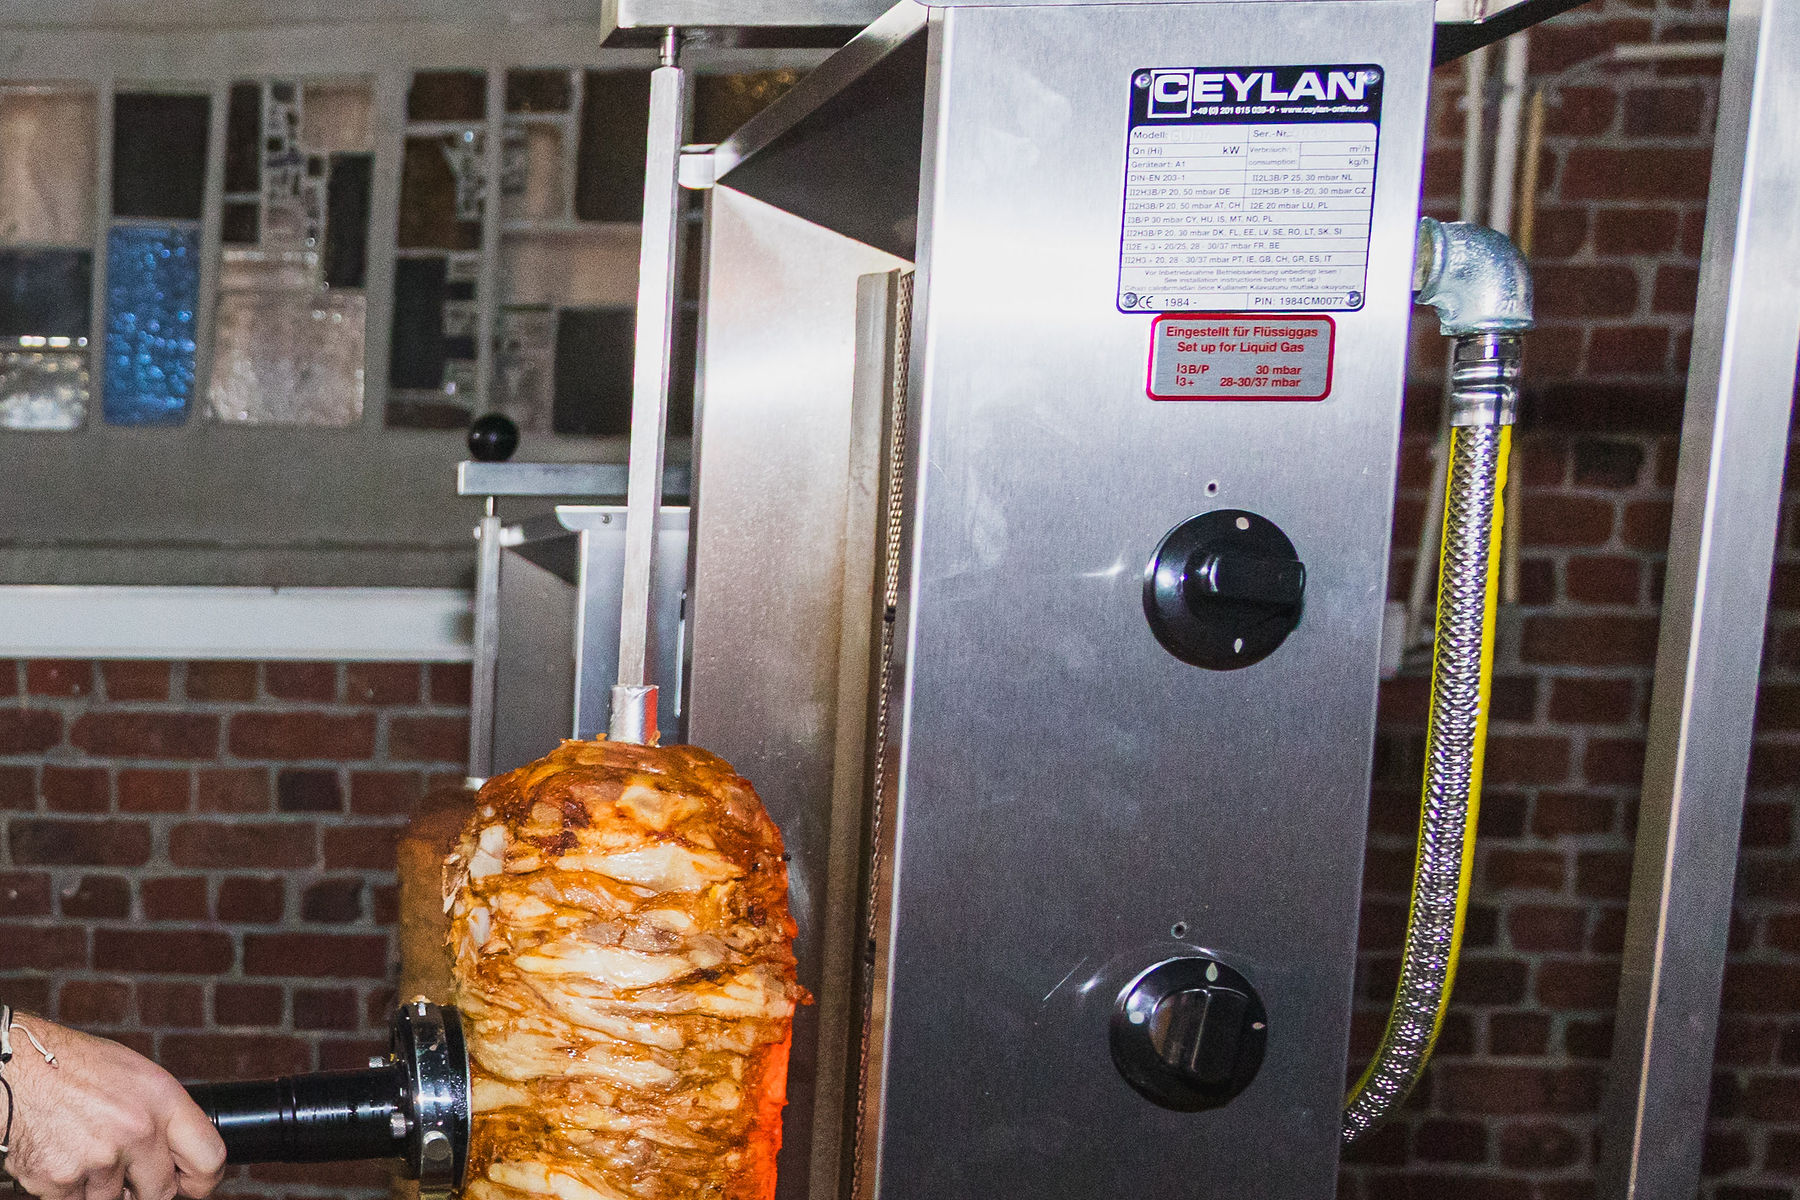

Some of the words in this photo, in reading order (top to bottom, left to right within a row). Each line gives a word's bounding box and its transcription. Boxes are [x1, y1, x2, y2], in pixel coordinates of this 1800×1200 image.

[1153, 70, 1366, 104] CEYLAN
[1222, 146, 1240, 154] kW
[1348, 157, 1369, 167] kg/h
[1165, 298, 1190, 307] 1984
[1166, 326, 1230, 339] Eingestellt
[1233, 326, 1249, 337] für
[1253, 326, 1318, 339] Flüssiggas
[1177, 341, 1197, 352] Set
[1200, 344, 1216, 354] up
[1219, 341, 1236, 352] for
[1240, 341, 1277, 354] Liquid
[1280, 342, 1304, 352] Gas
[1255, 365, 1269, 375] 30
[1272, 365, 1301, 375] mbar
[1220, 377, 1268, 387] 28-30/37
[1271, 377, 1301, 387] mbar
